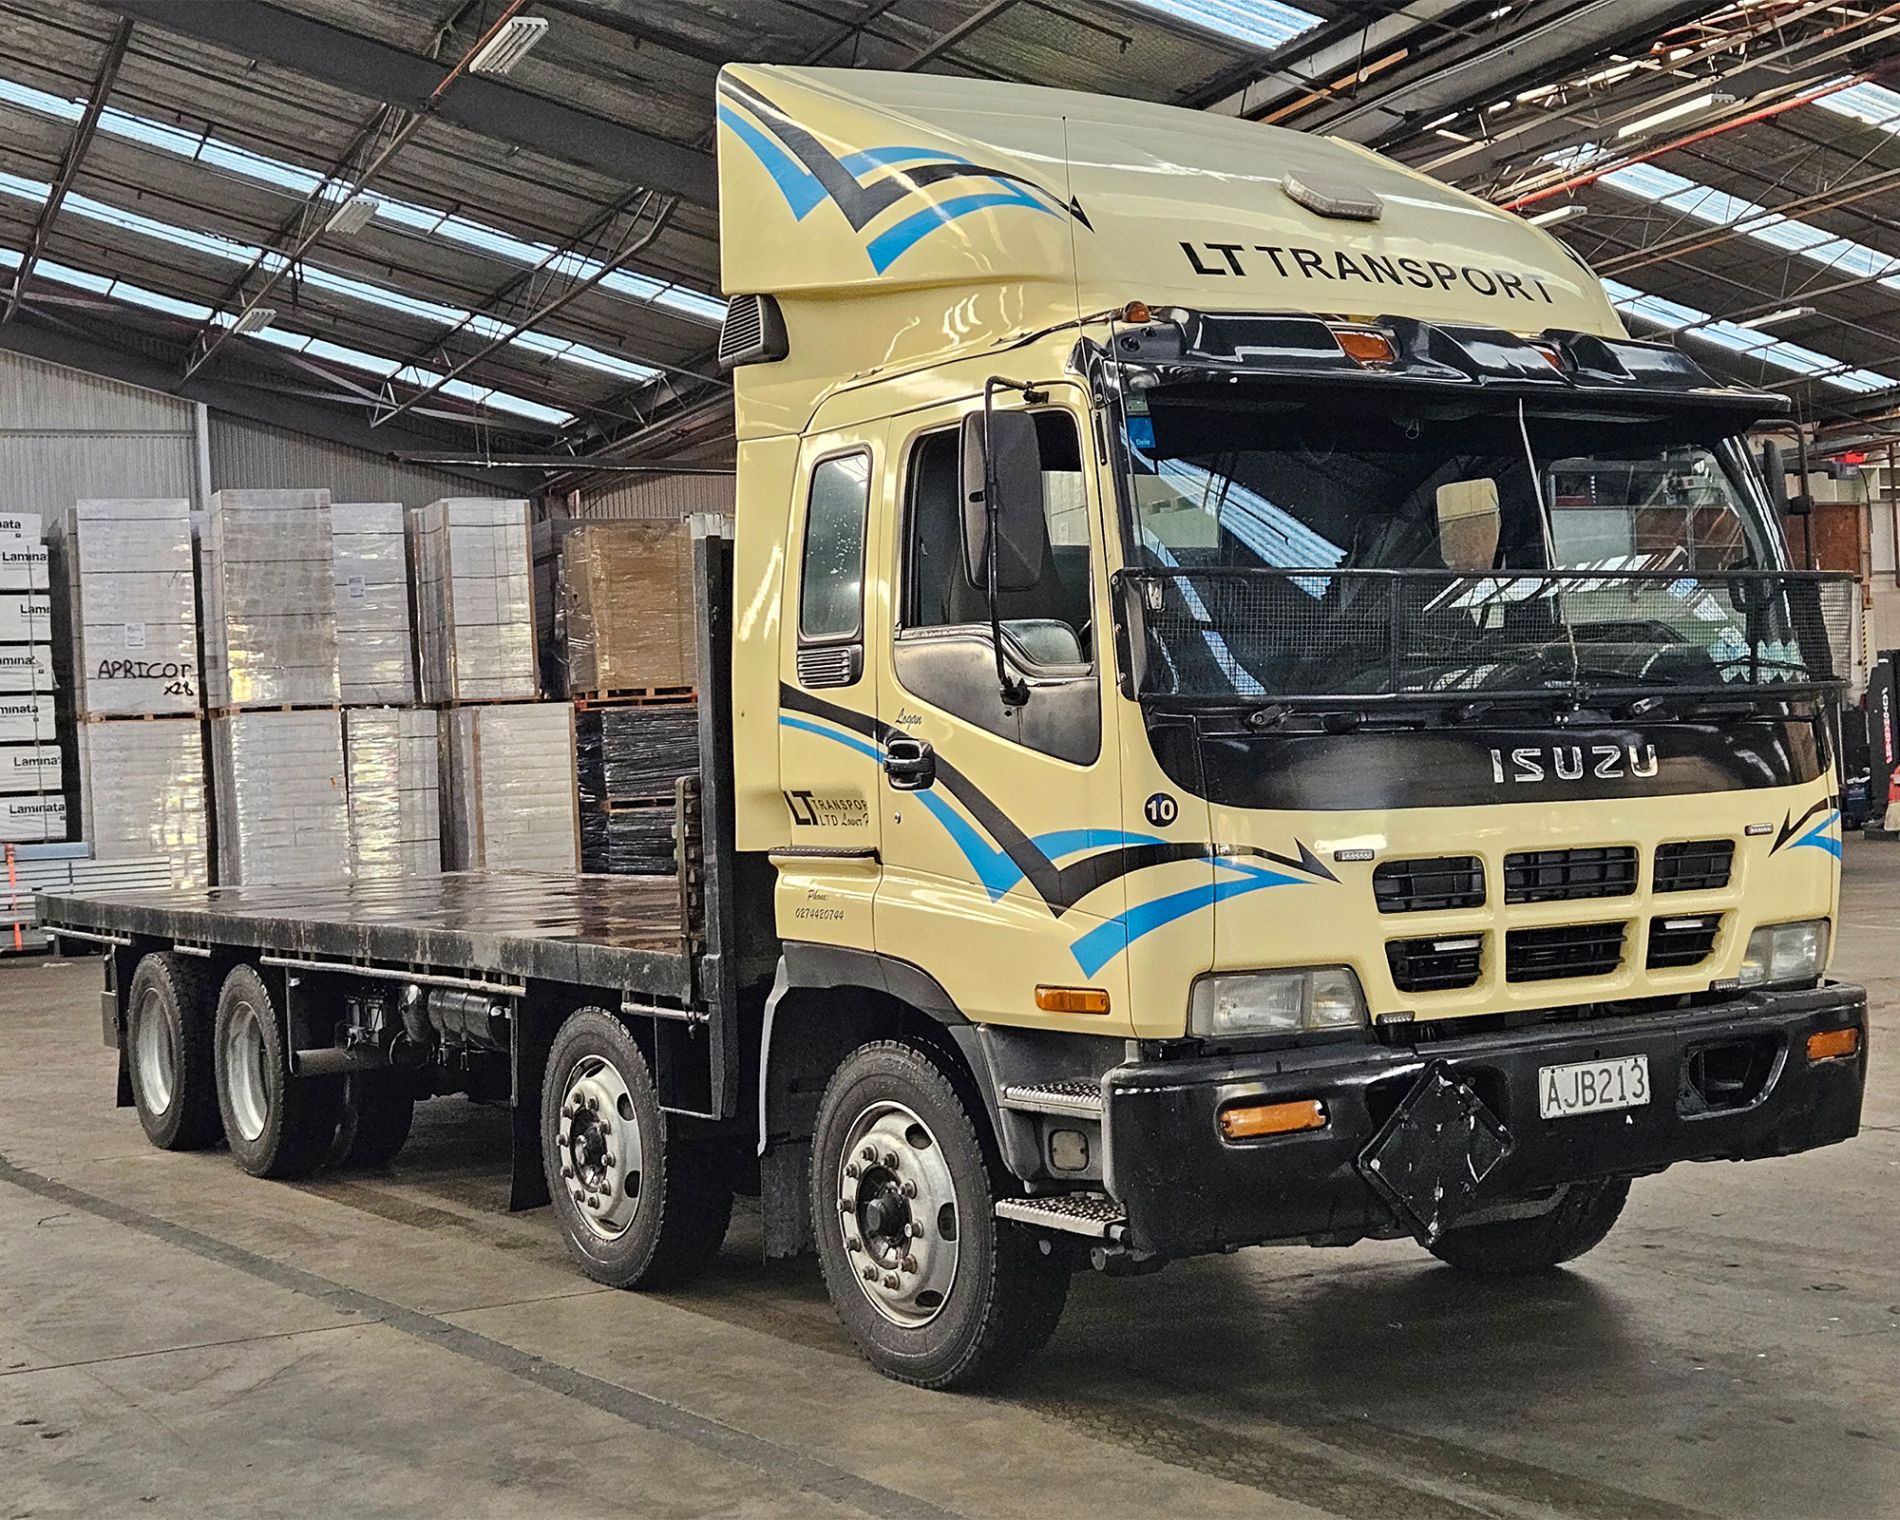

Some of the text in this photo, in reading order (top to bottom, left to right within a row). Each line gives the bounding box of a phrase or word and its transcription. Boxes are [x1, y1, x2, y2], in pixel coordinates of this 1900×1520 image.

[1179, 241, 1553, 304] LT TRANSPORT
[0, 519, 21, 529] ata
[98, 659, 192, 679] APRICOT
[895, 707, 922, 731] Logan
[1489, 744, 1659, 783] ISUZU
[9, 802, 66, 814] Laminata
[783, 790, 819, 826] LT
[1147, 799, 1175, 820] 10
[819, 814, 839, 826] LTD
[1547, 1064, 1645, 1112] AJB213
